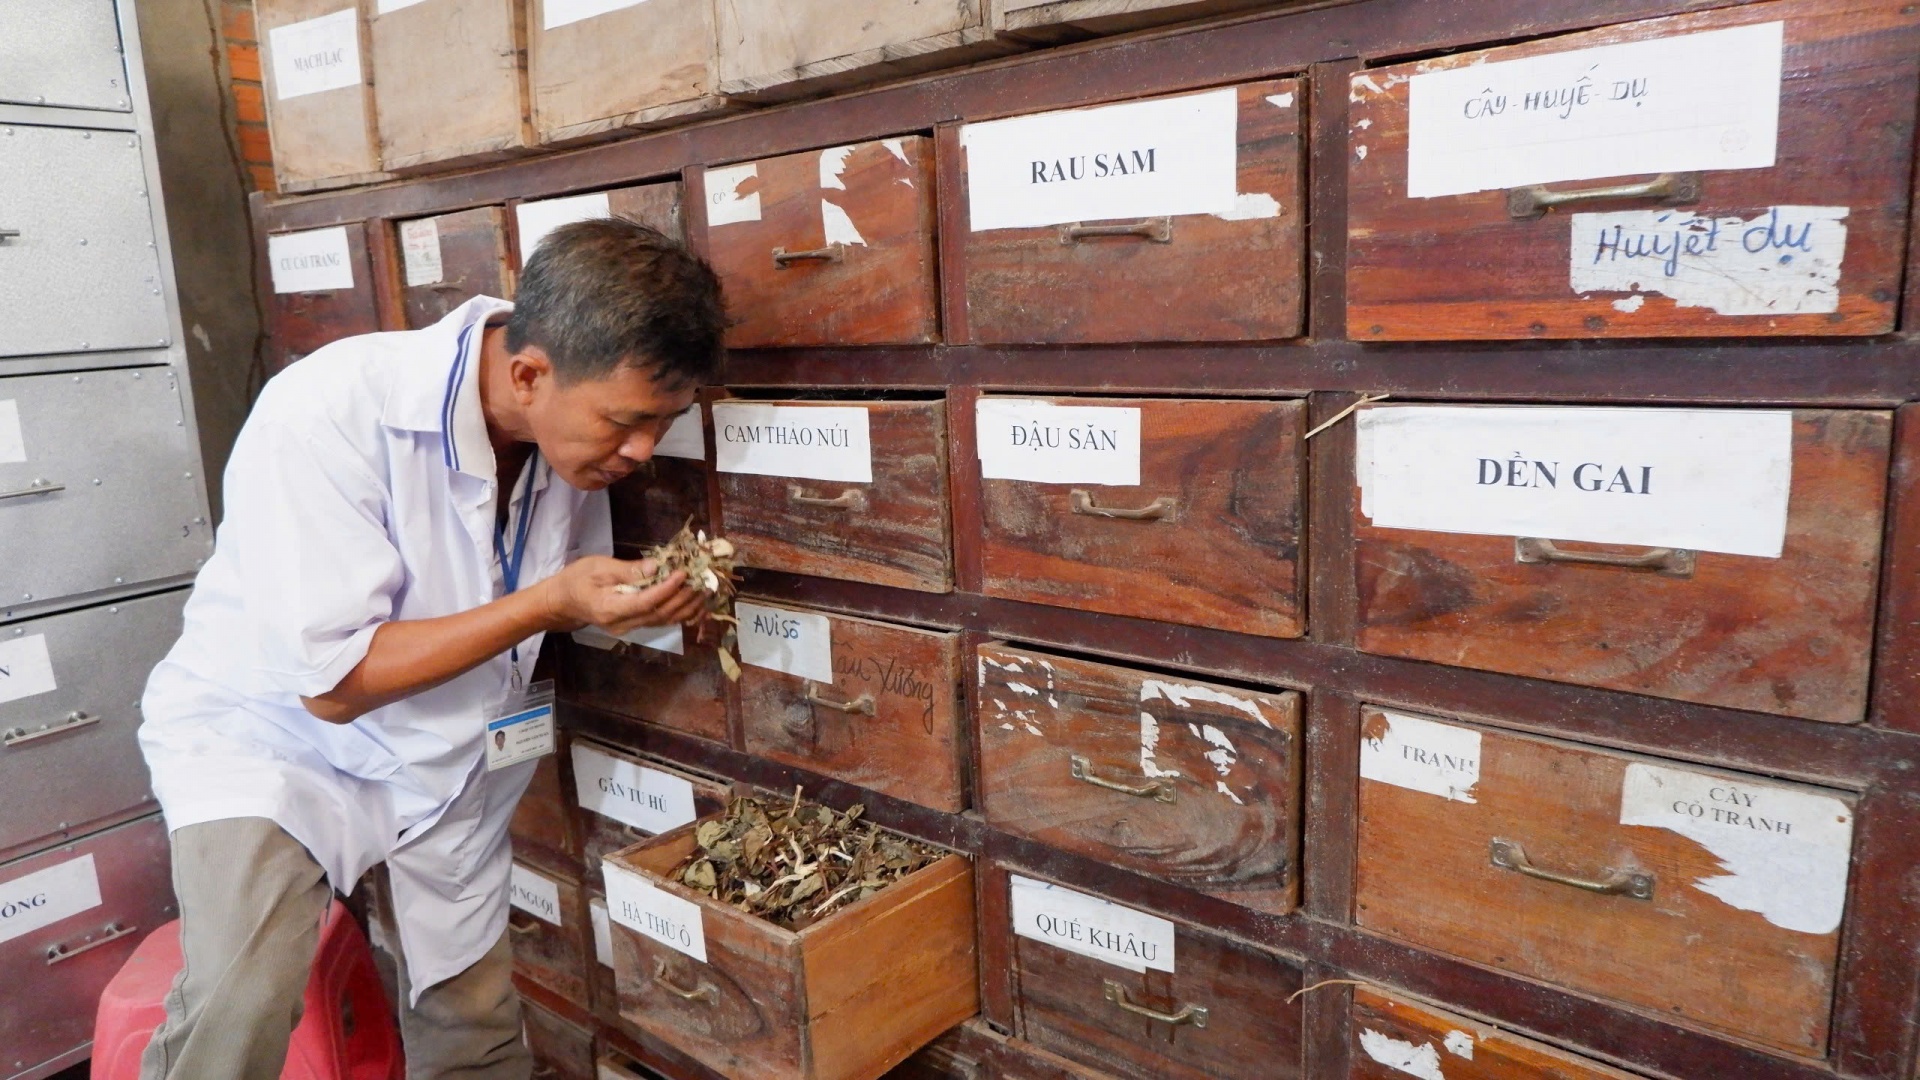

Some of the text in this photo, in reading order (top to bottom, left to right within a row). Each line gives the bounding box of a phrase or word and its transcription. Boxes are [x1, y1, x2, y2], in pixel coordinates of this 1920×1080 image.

[1030, 147, 1157, 184] RAU SAM
[724, 422, 850, 448] CAM THẢO NÚI
[1011, 420, 1117, 452] ĐẬU SĂN
[1476, 451, 1655, 495] DỀN GAI
[627, 786, 645, 805] TU
[648, 794, 668, 813] HÚ
[1709, 786, 1758, 808] CÂY
[1711, 807, 1792, 835] TRANH
[622, 900, 643, 925] HÀ
[680, 924, 691, 947] Ô
[1088, 926, 1158, 961] KHÂU
